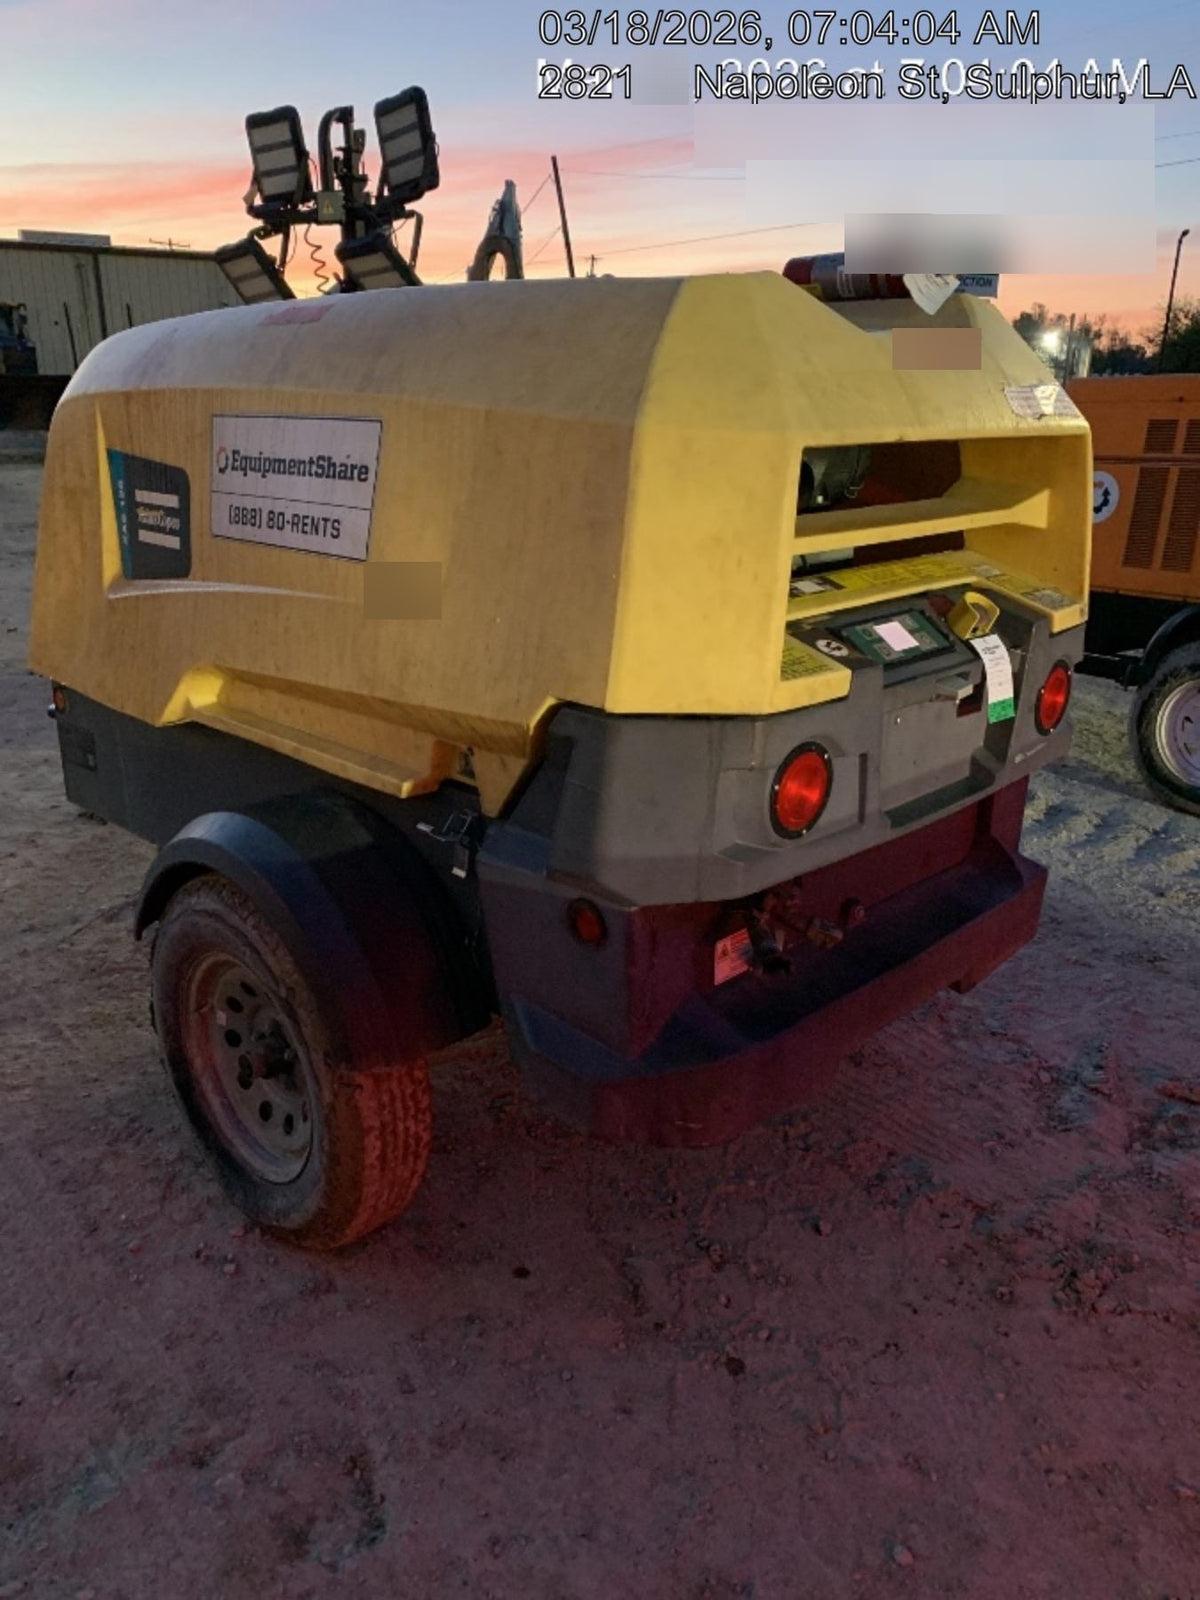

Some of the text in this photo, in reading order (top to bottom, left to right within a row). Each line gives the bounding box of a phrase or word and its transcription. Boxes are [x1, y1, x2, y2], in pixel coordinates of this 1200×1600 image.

[231, 449, 369, 482] EquipmentShare
[228, 504, 341, 539] (888) 80-RENTS
